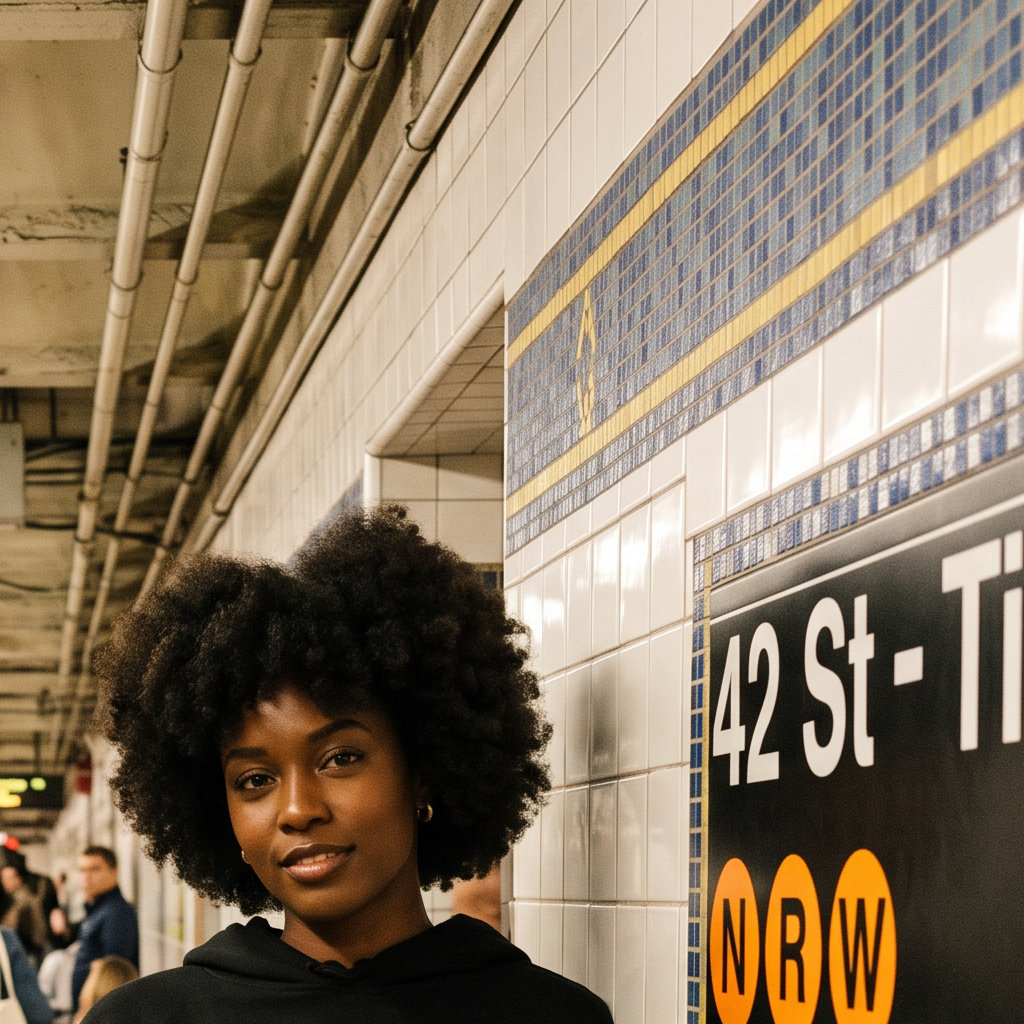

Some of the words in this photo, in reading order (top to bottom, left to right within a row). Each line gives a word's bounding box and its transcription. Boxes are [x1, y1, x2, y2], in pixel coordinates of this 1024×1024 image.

[712, 621, 780, 787] 42
[802, 593, 875, 778] St
[721, 898, 745, 995] N
[779, 897, 806, 1003] R
[838, 898, 886, 1012] W
